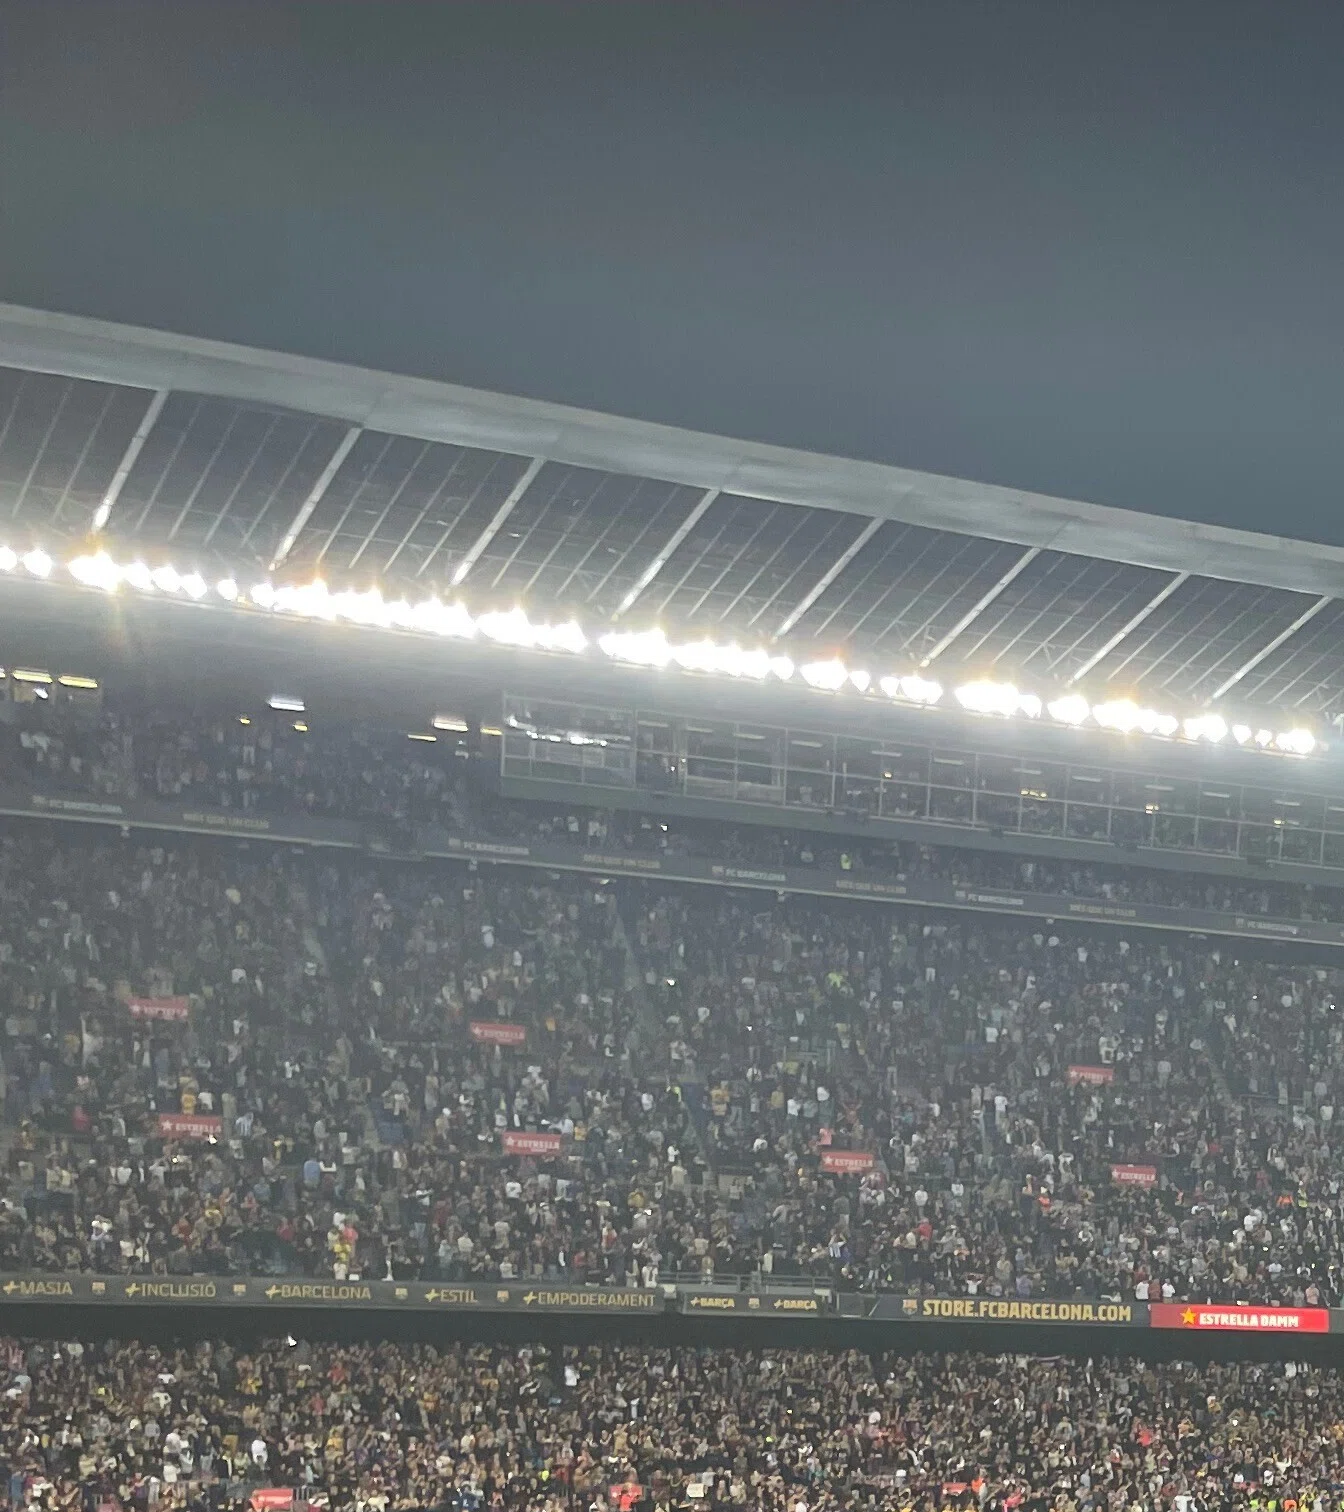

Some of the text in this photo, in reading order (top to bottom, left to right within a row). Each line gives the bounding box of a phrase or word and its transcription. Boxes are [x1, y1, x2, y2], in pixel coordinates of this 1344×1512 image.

[922, 1299, 1132, 1322] STORE.FCBARCELONA.COM
[1199, 1312, 1300, 1329] ESTRELLA DAMM
